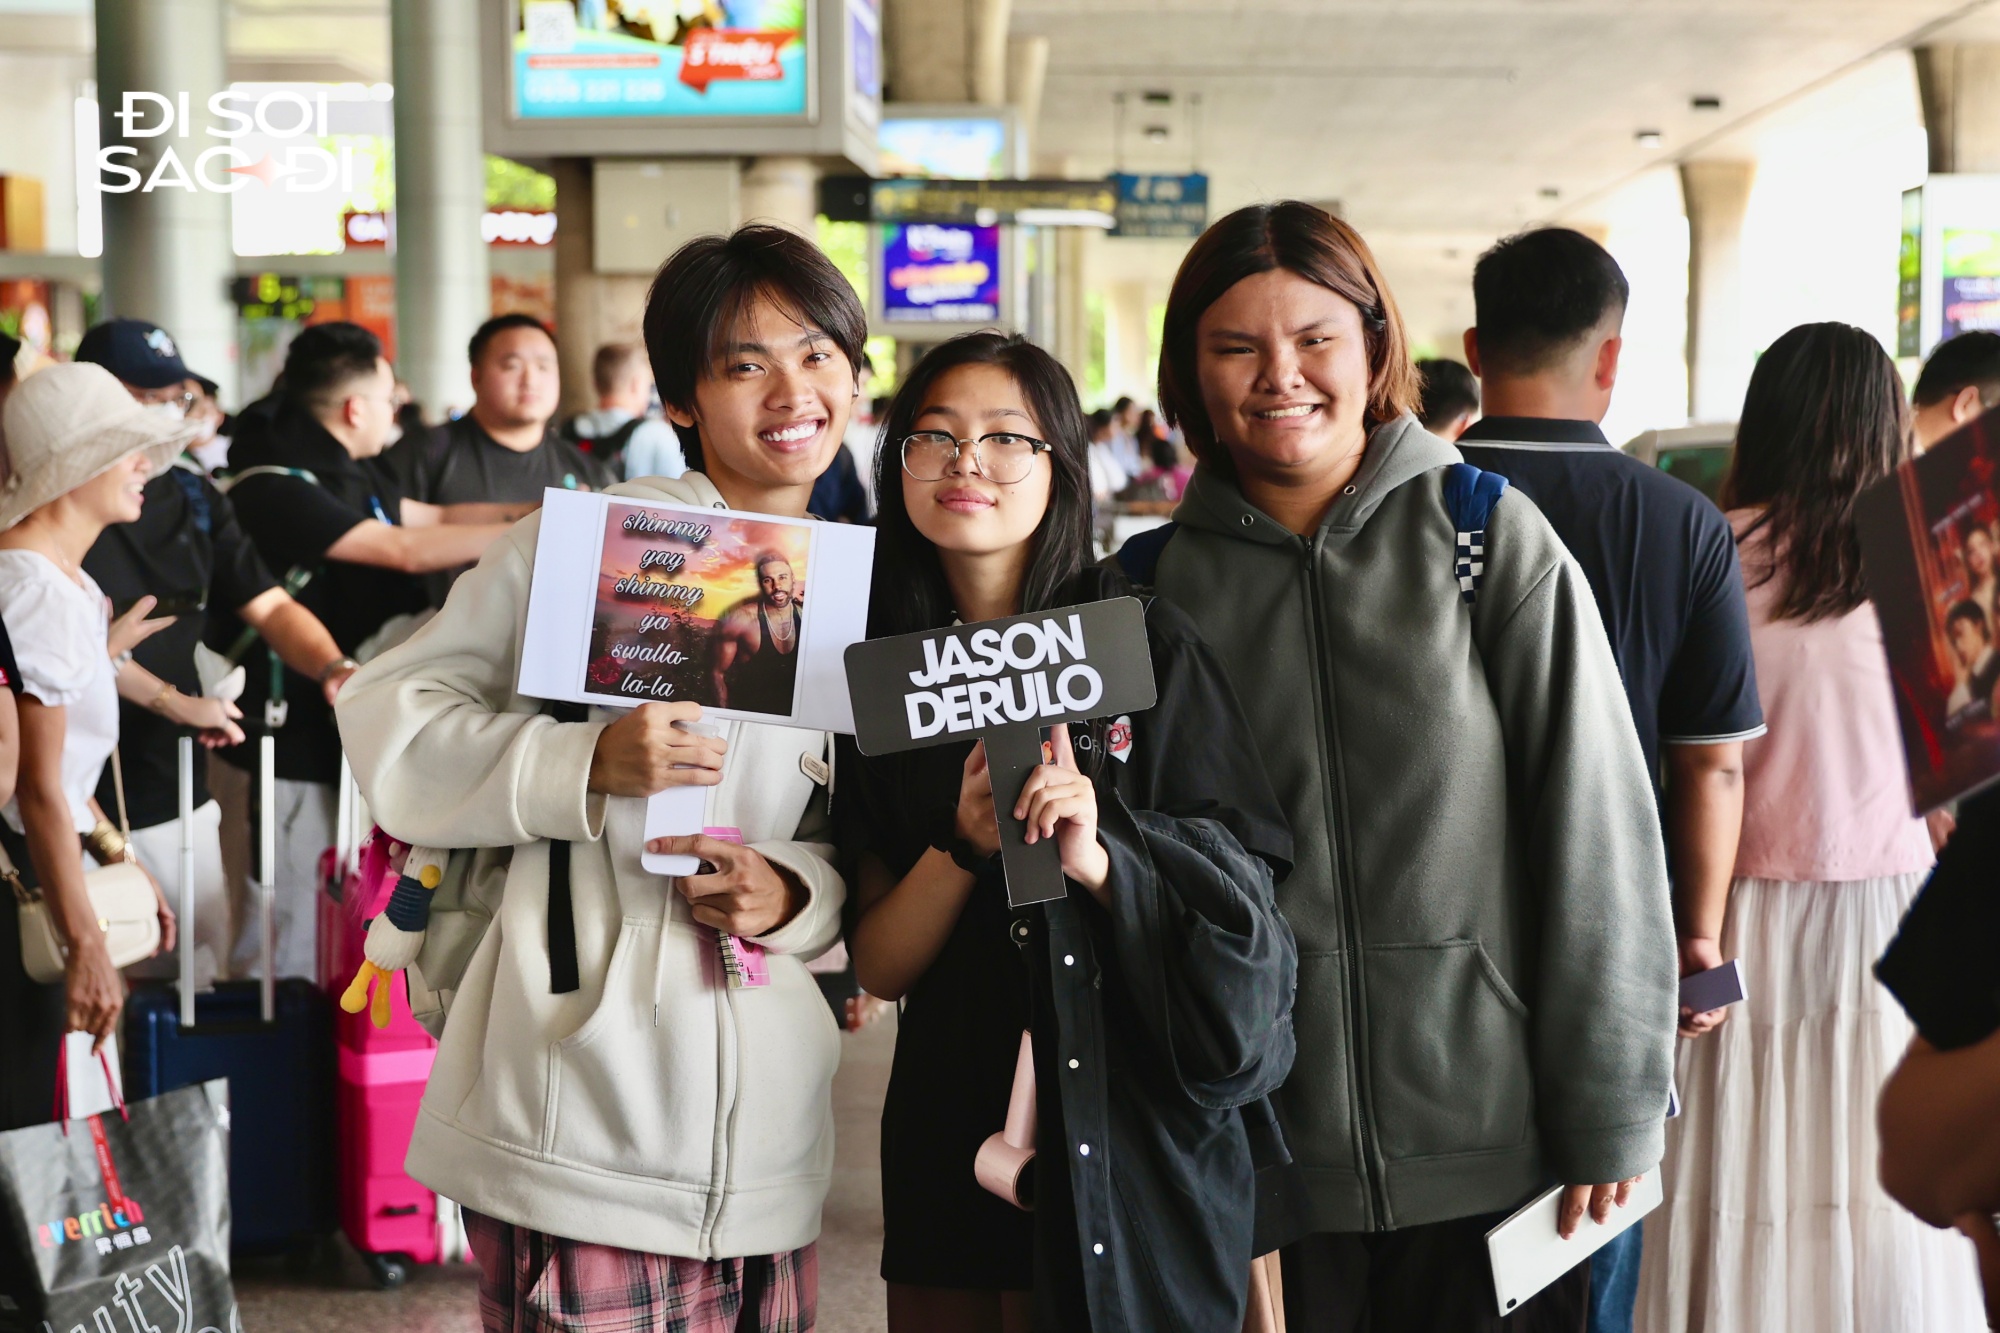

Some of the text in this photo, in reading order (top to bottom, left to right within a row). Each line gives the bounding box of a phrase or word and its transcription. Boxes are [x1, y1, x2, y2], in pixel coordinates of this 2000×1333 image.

[623, 510, 711, 542] shimmy
[639, 549, 686, 571] yay
[614, 574, 704, 606] shimmy
[638, 613, 671, 633] ya
[611, 642, 689, 665] swalla-
[908, 614, 1086, 687] JASON
[620, 672, 674, 697] la-la
[904, 664, 1103, 739] DERULO
